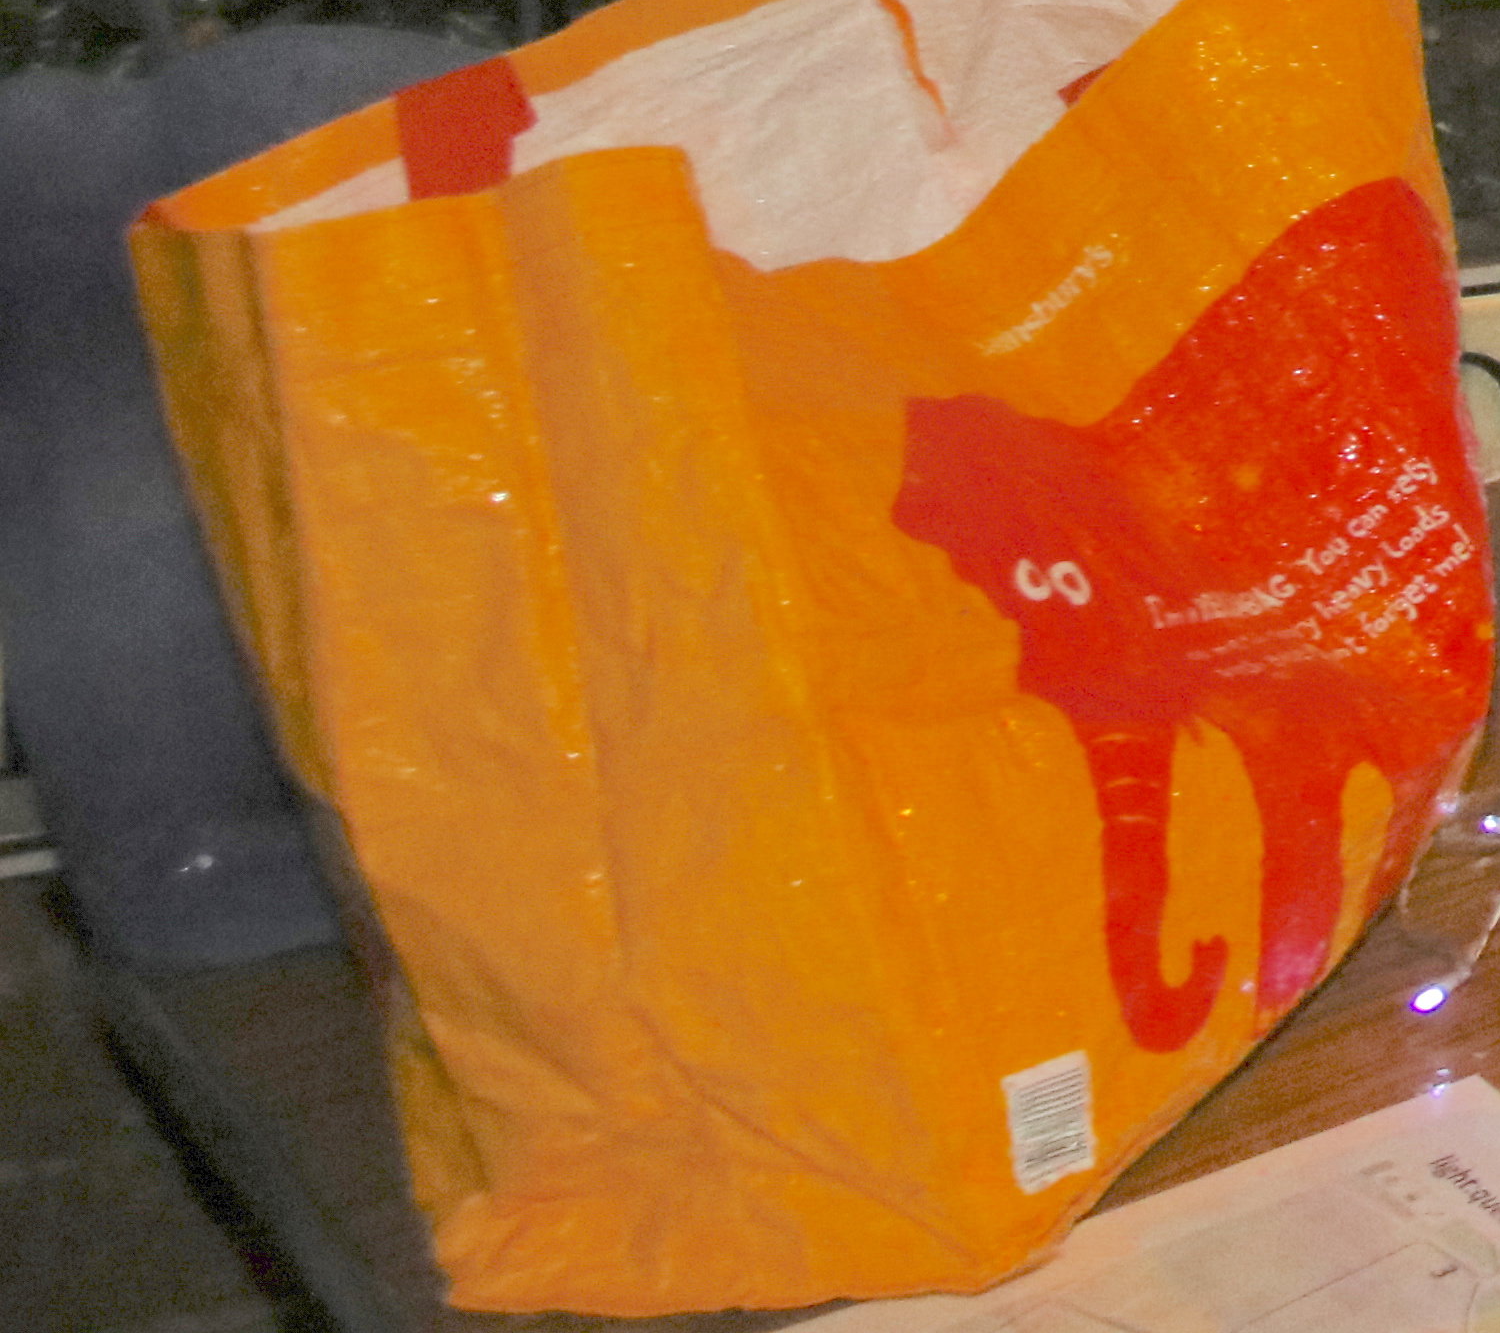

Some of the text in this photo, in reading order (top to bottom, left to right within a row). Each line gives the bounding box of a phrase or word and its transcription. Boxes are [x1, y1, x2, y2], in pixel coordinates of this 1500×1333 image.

[1298, 536, 1349, 575] You
[1348, 503, 1388, 538] can
[1312, 559, 1389, 620] heavy
[1359, 522, 1474, 639] forget me!
